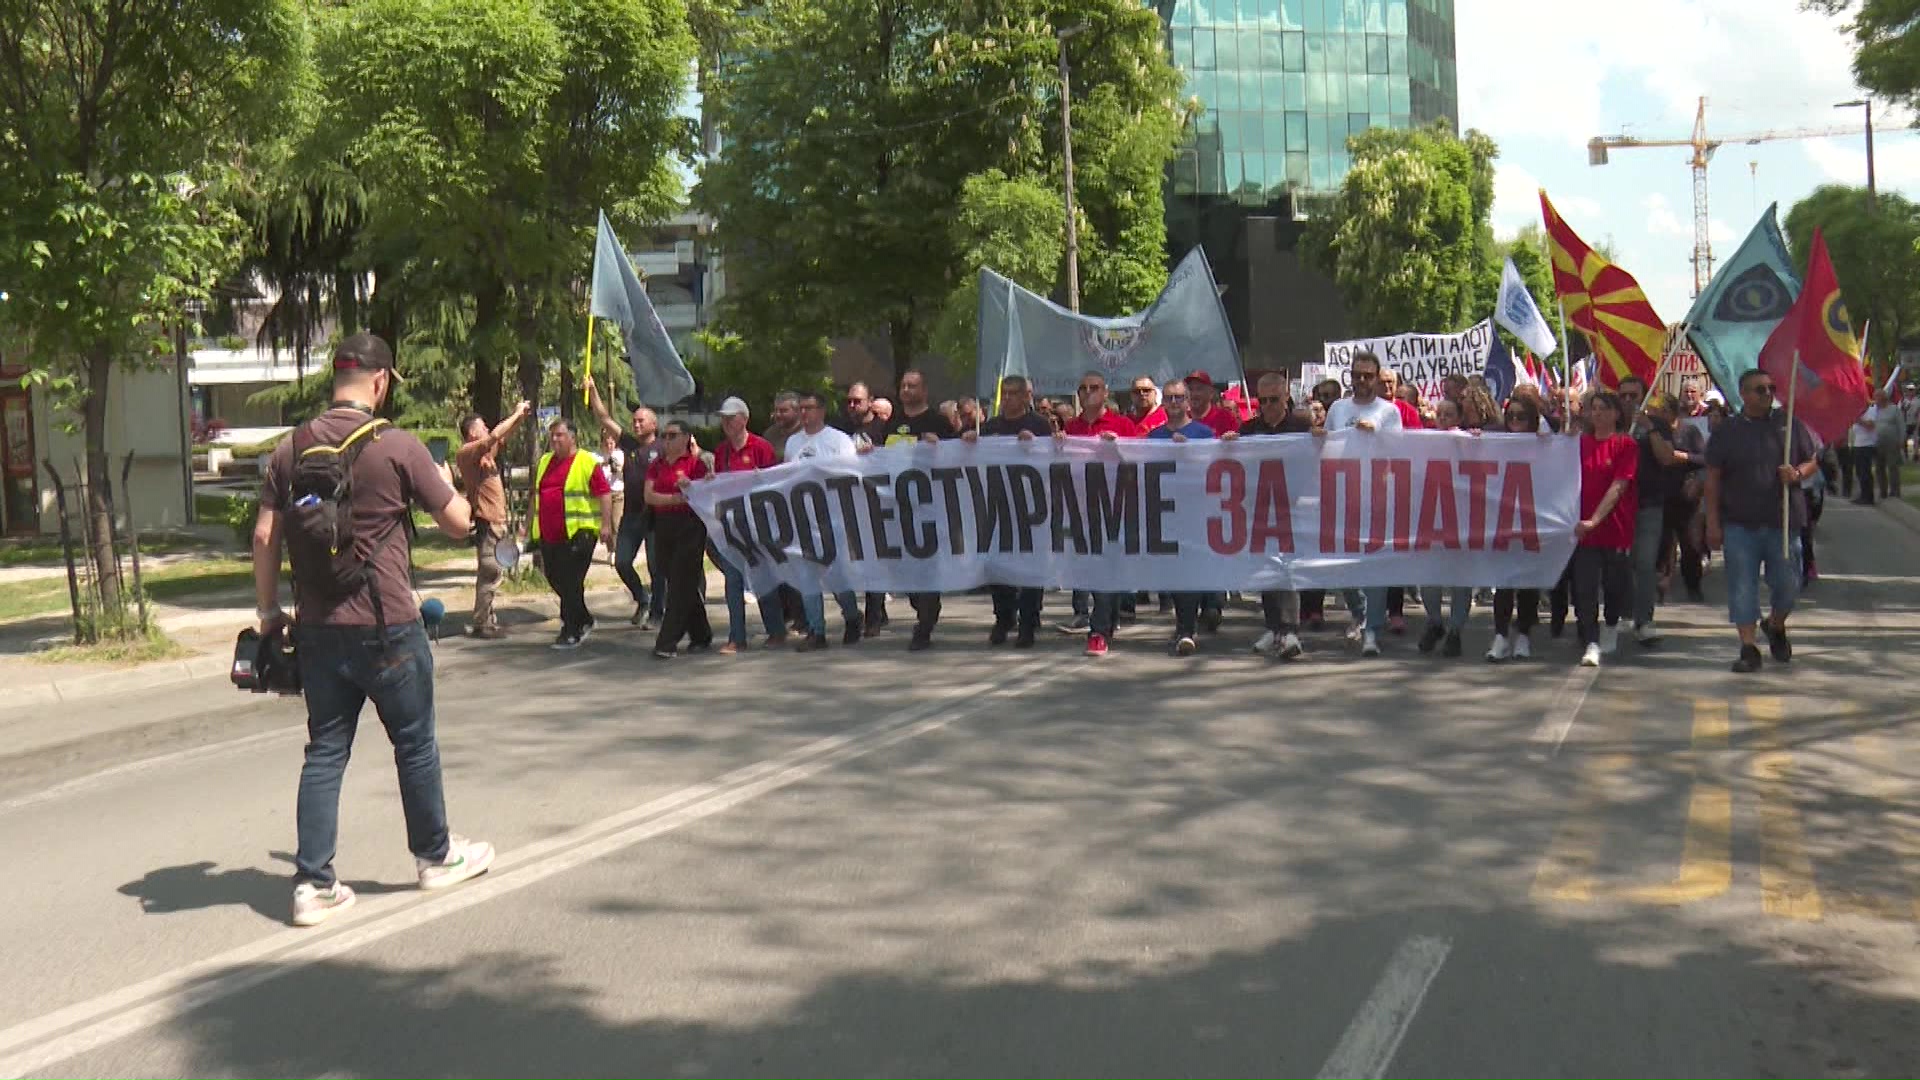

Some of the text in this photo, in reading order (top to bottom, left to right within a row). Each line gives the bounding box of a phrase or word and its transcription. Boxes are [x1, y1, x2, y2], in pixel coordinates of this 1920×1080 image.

[715, 458, 1541, 567] ПРОТЕСТИРАМЕ ЗА ПЛАТА
